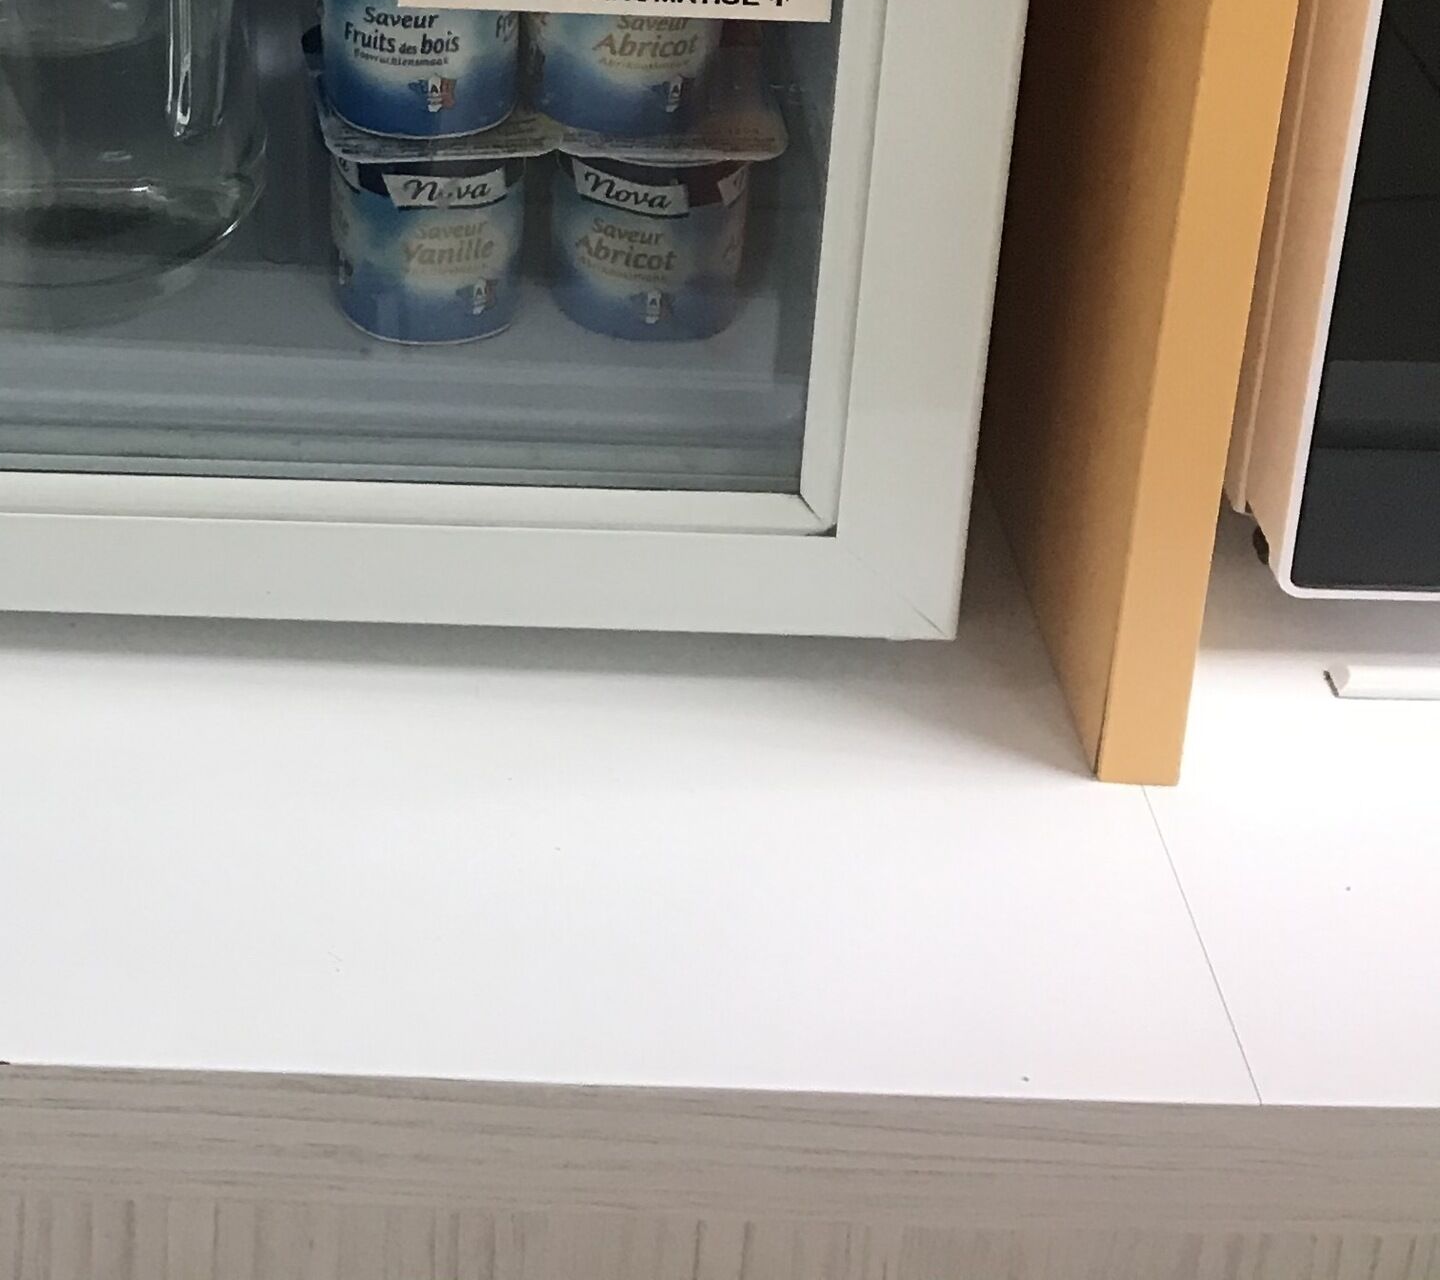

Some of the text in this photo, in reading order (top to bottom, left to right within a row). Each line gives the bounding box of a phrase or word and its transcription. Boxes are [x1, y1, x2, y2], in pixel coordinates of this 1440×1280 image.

[363, 6, 439, 29] Saveur
[344, 21, 460, 55] Fruits des bois
[592, 33, 699, 58] Abricot
[583, 170, 675, 211] Nova
[591, 216, 665, 245] Saveur
[403, 238, 495, 266] Vanille
[575, 233, 679, 272] Abricot
